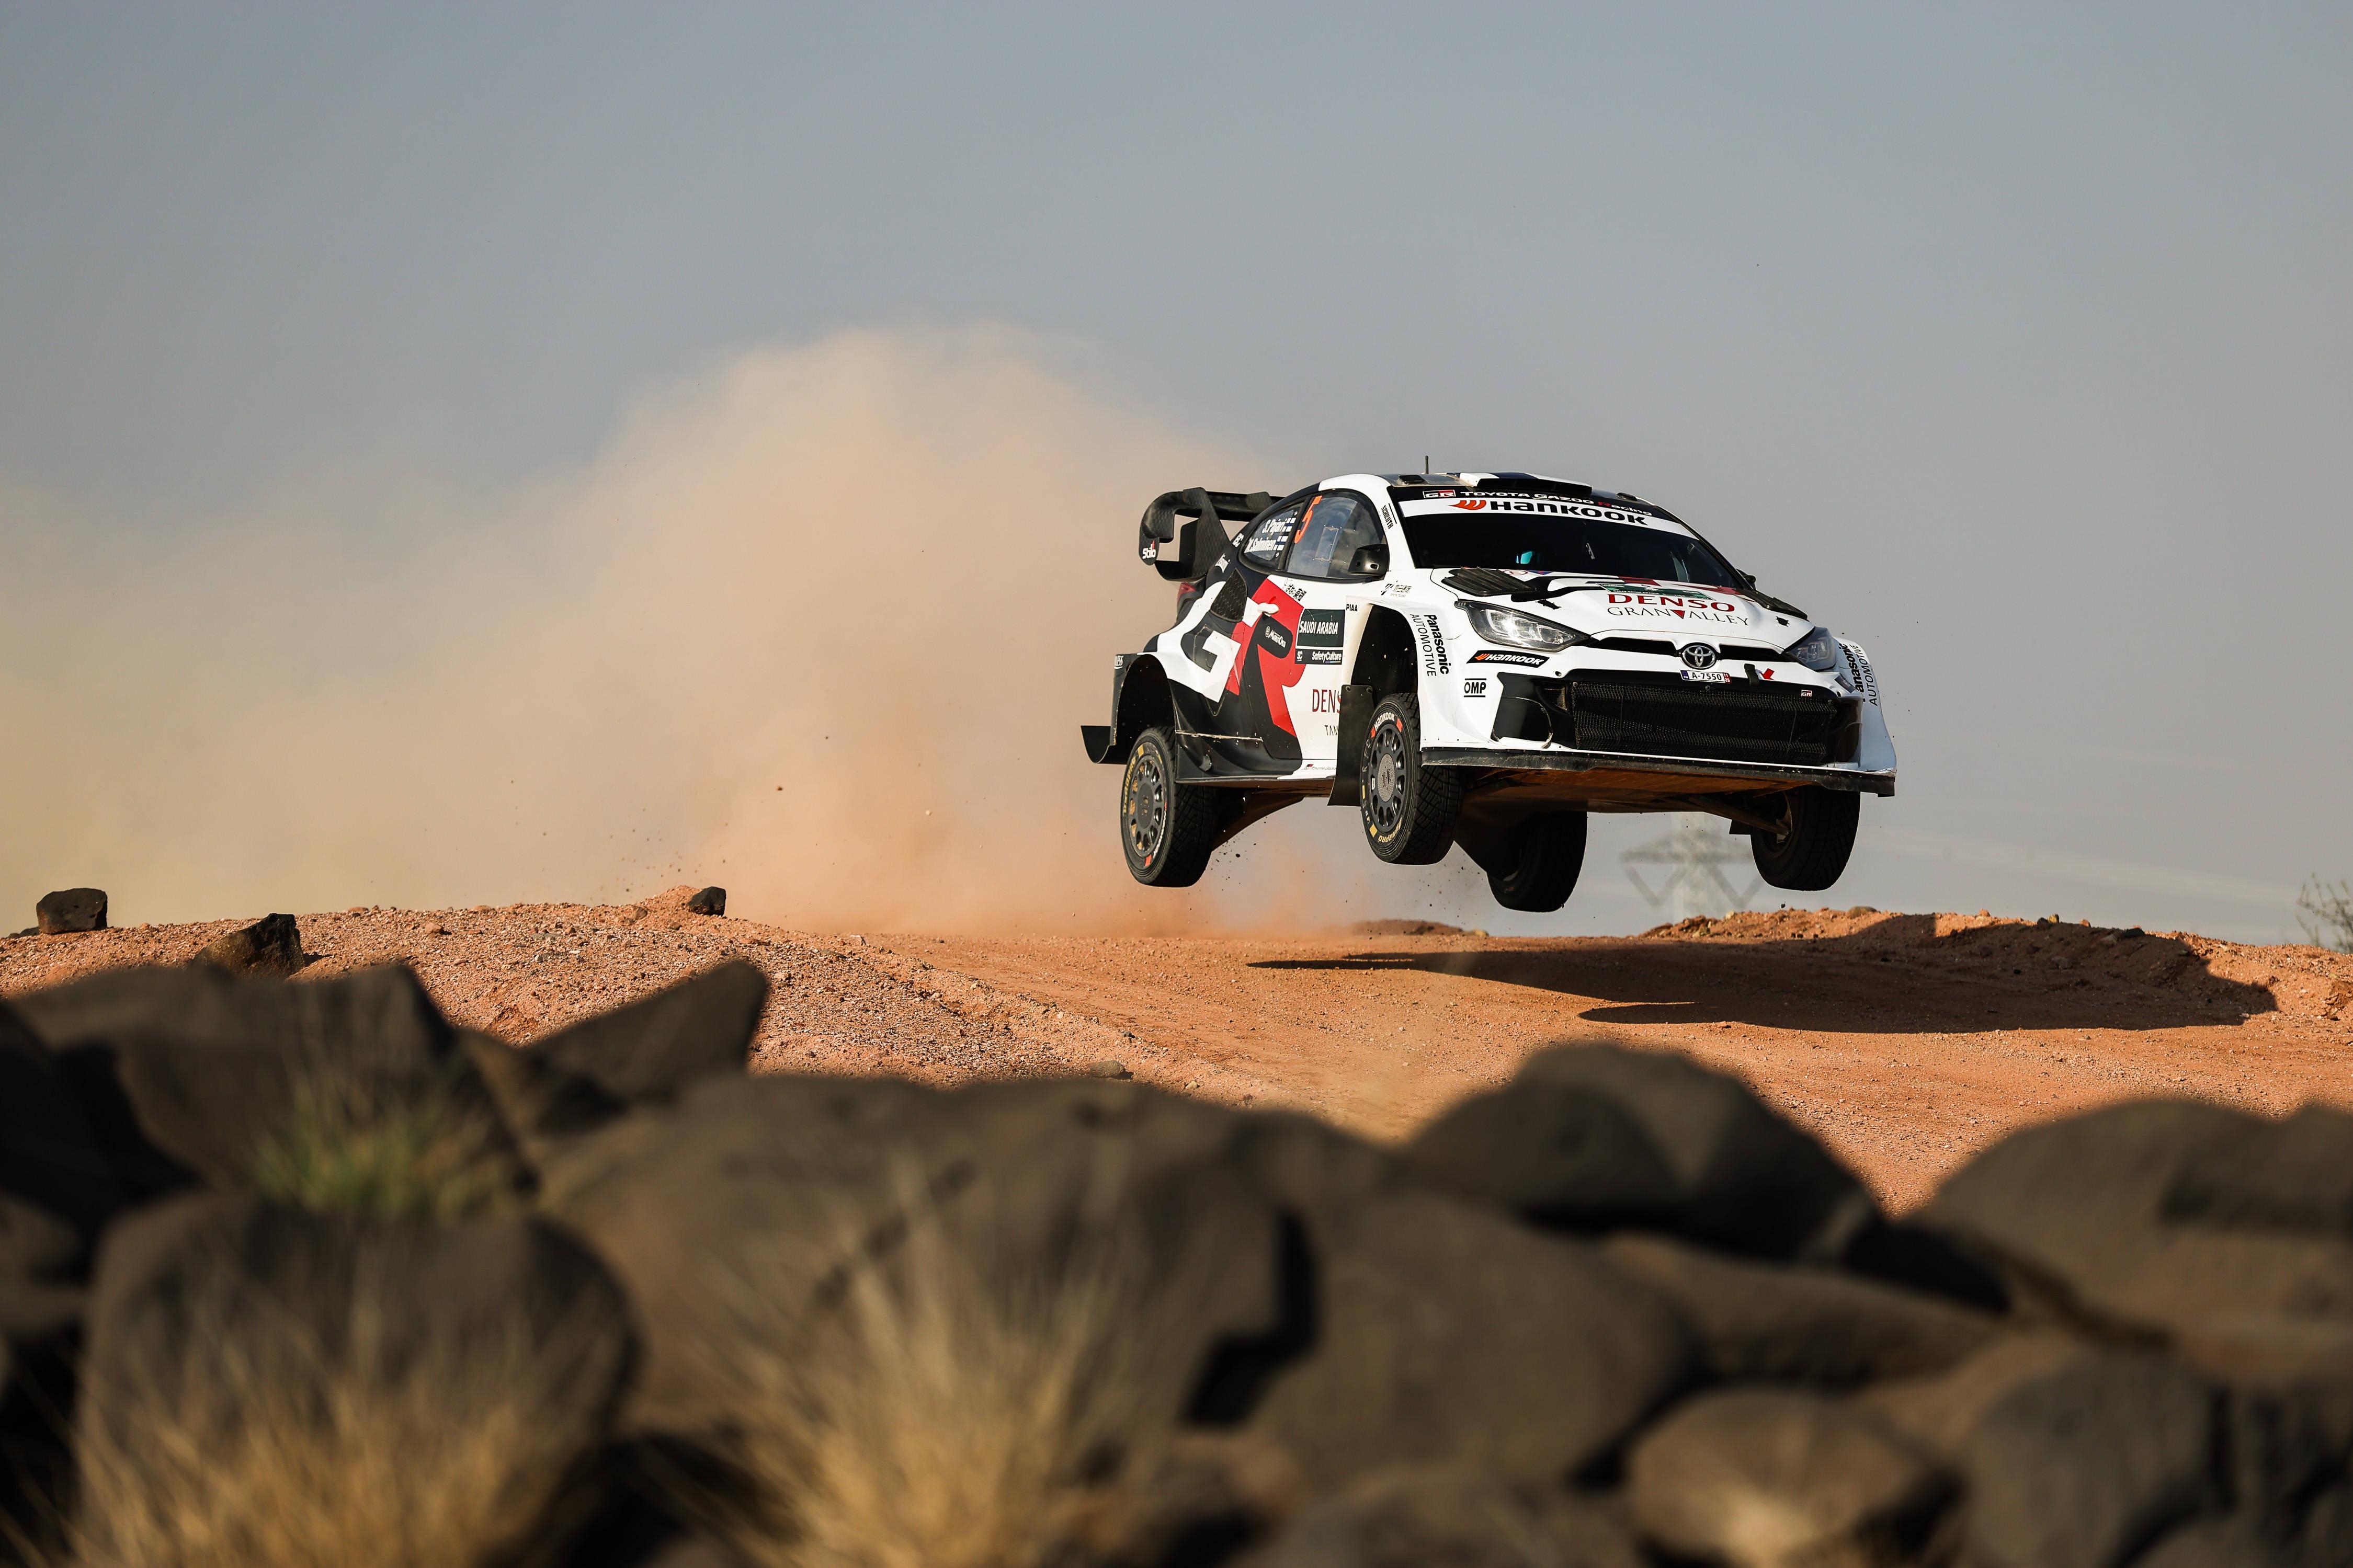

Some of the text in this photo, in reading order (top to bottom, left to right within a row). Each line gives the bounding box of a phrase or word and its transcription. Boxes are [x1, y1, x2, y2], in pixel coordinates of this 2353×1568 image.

[1534, 494, 1594, 504] GAZOO
[1294, 495, 1322, 544] 5
[1142, 540, 1156, 559] Stilo
[1607, 593, 1735, 612] DENSO
[1299, 621, 1338, 635] SAUDI ARABIA
[1409, 614, 1437, 677] AUTOMOTIVE
[1424, 614, 1451, 674] Panasonic
[1312, 651, 1342, 663] SafetyCulture
[1692, 672, 1722, 680] A-7550
[1838, 643, 1866, 702] anasonic
[1849, 644, 1878, 706] AUTOMOTIVE
[1464, 681, 1486, 694] OMP
[1312, 689, 1342, 714] DENS
